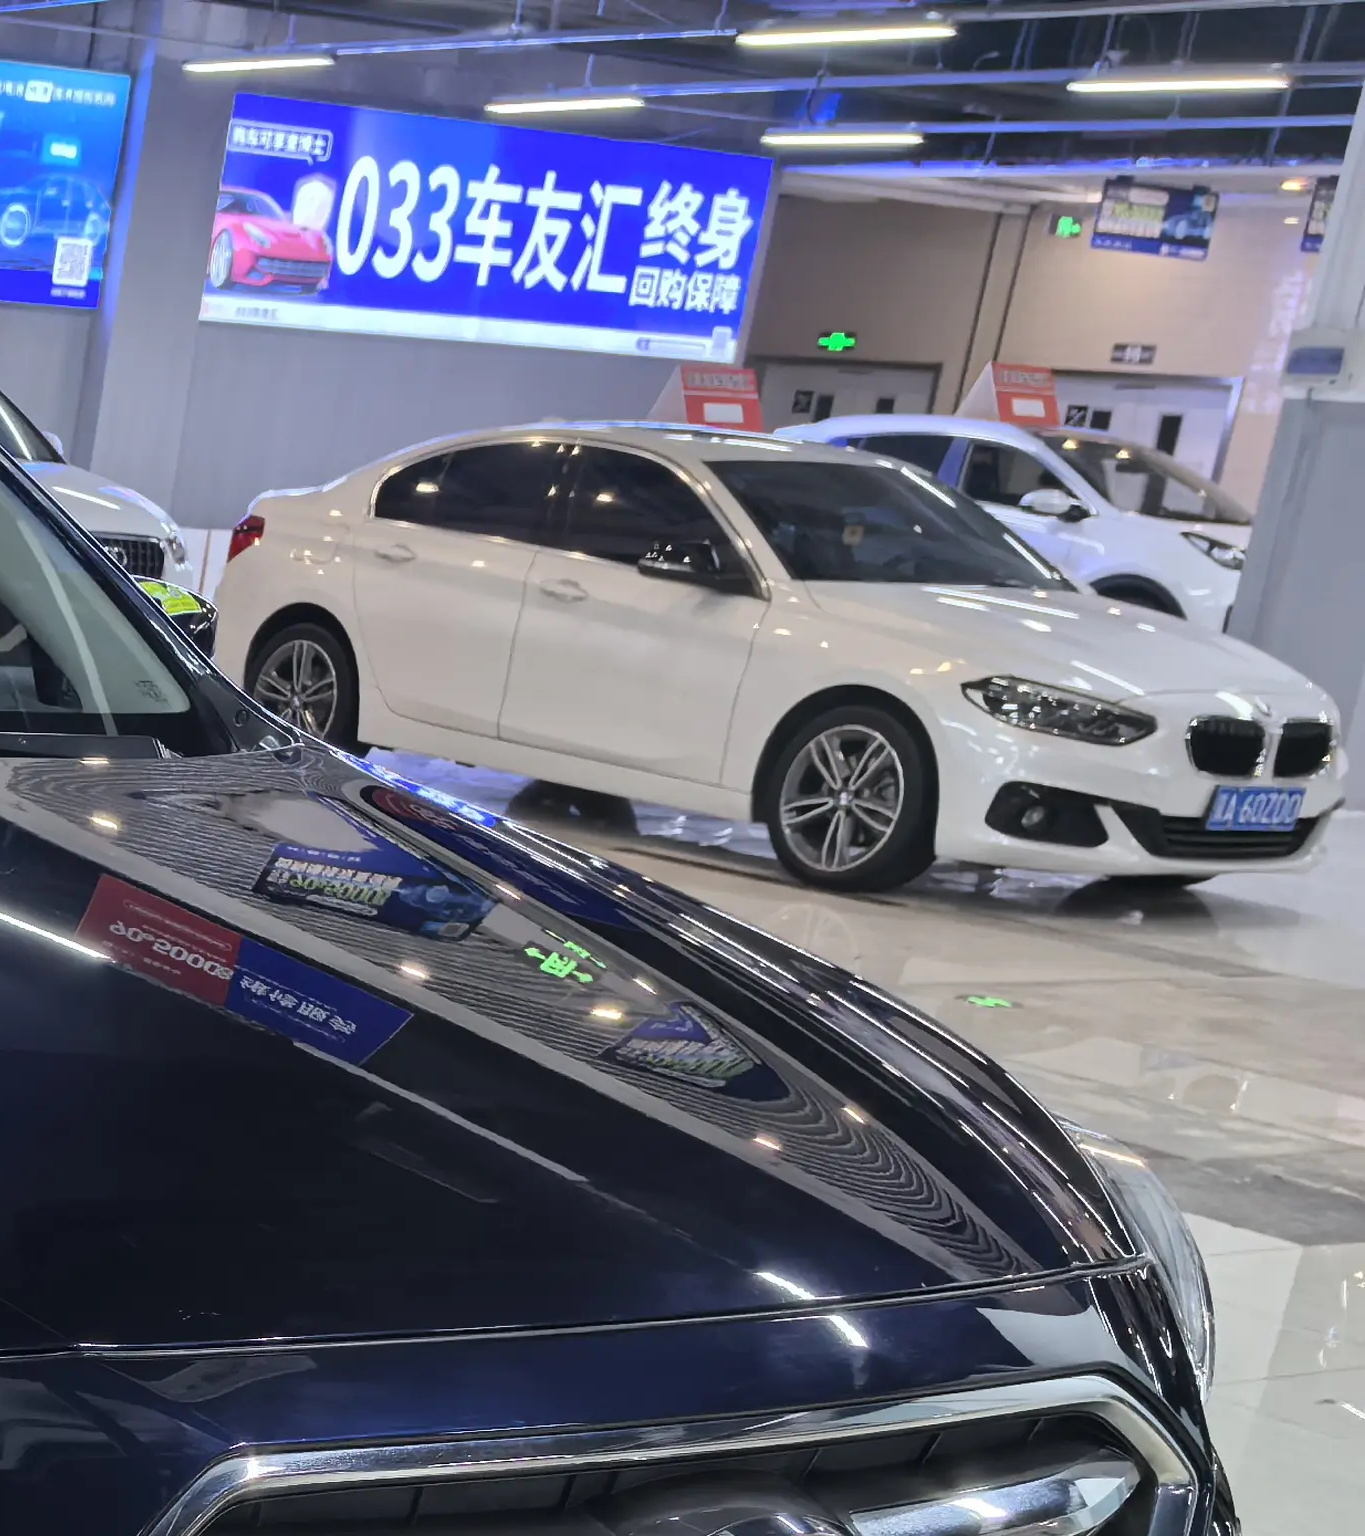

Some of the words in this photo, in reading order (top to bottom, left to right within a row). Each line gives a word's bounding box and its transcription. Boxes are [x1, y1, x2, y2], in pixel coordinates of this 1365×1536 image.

[336, 156, 643, 294] 033车友汇
[640, 180, 752, 270] 终身
[628, 266, 741, 314] 回购保障
